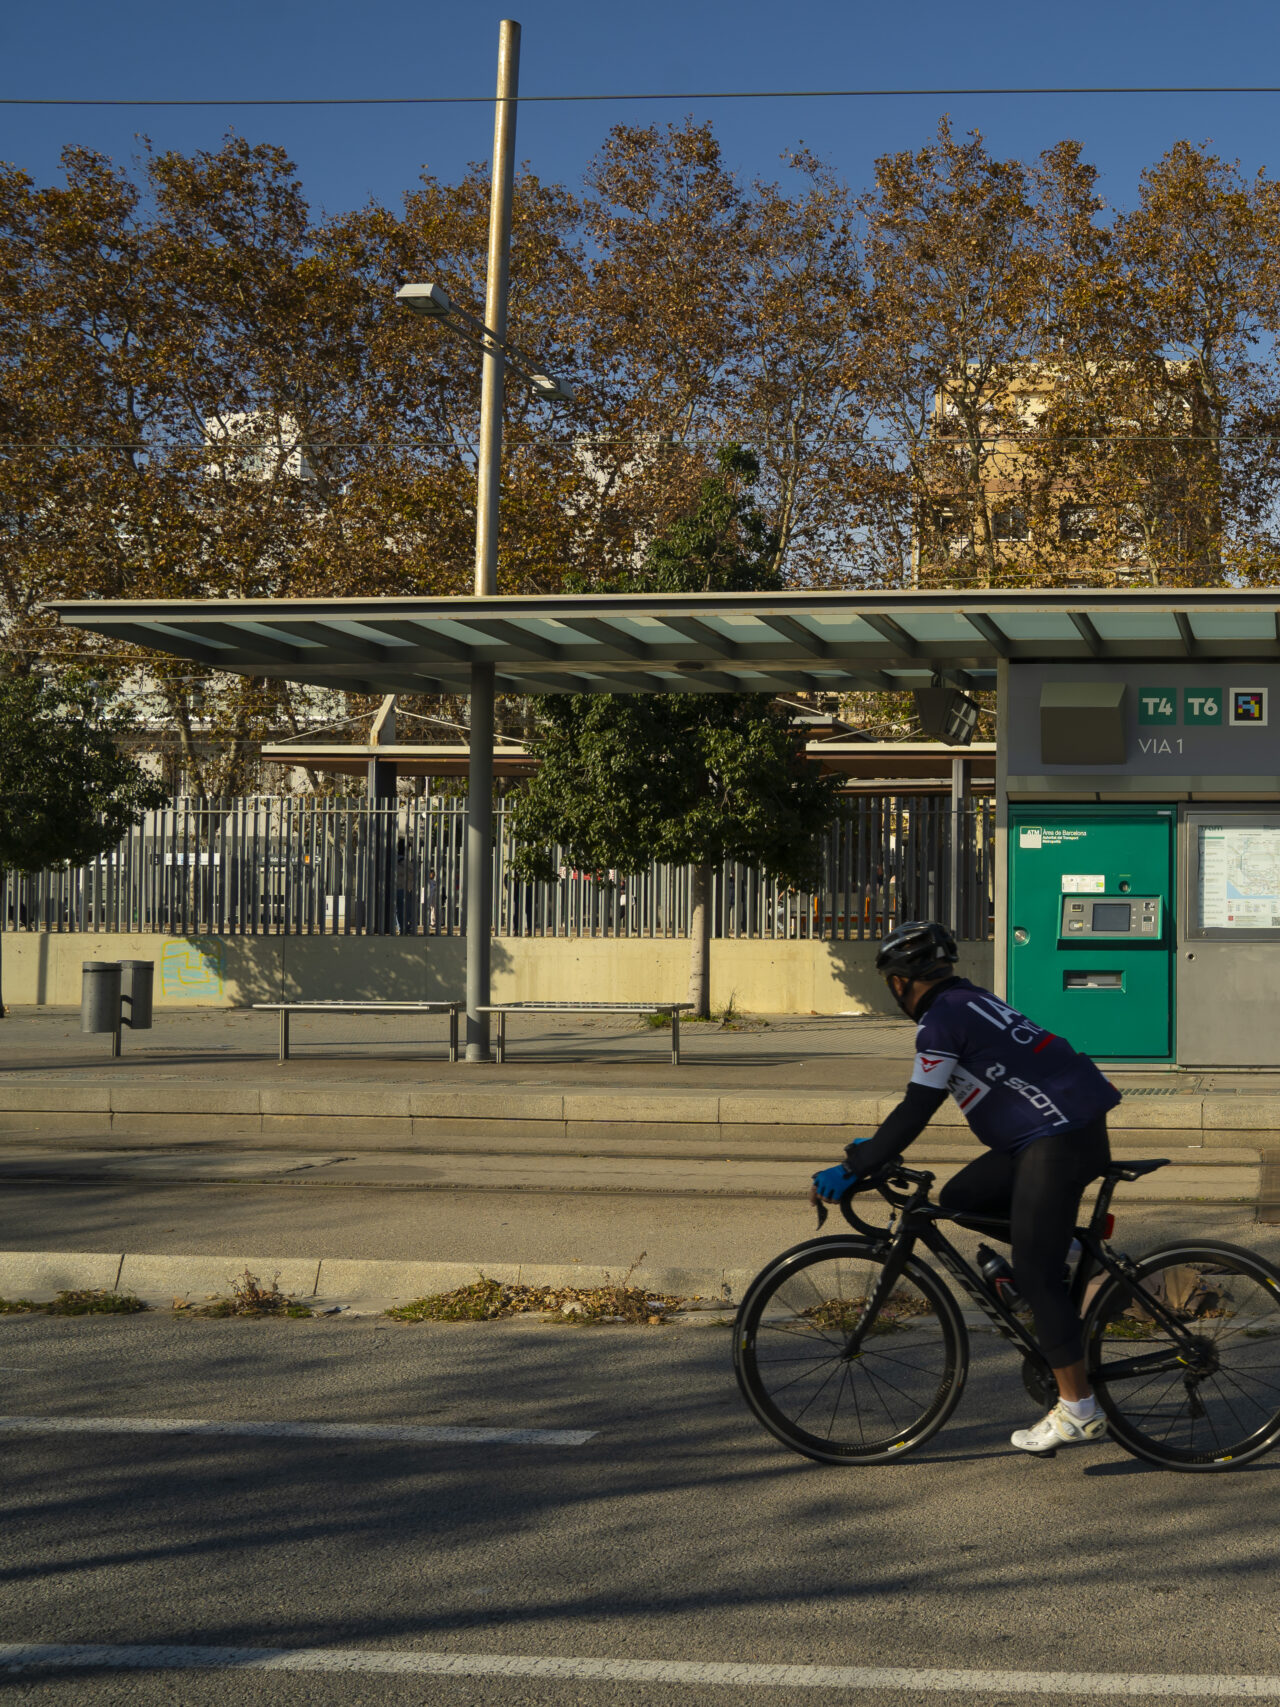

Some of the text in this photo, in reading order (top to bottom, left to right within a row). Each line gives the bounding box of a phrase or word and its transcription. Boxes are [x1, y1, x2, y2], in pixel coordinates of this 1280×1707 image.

[1142, 697, 1218, 716] T4 T6
[1138, 738, 1183, 754] VIA 1
[1003, 1077, 1071, 1127] SCOTT
